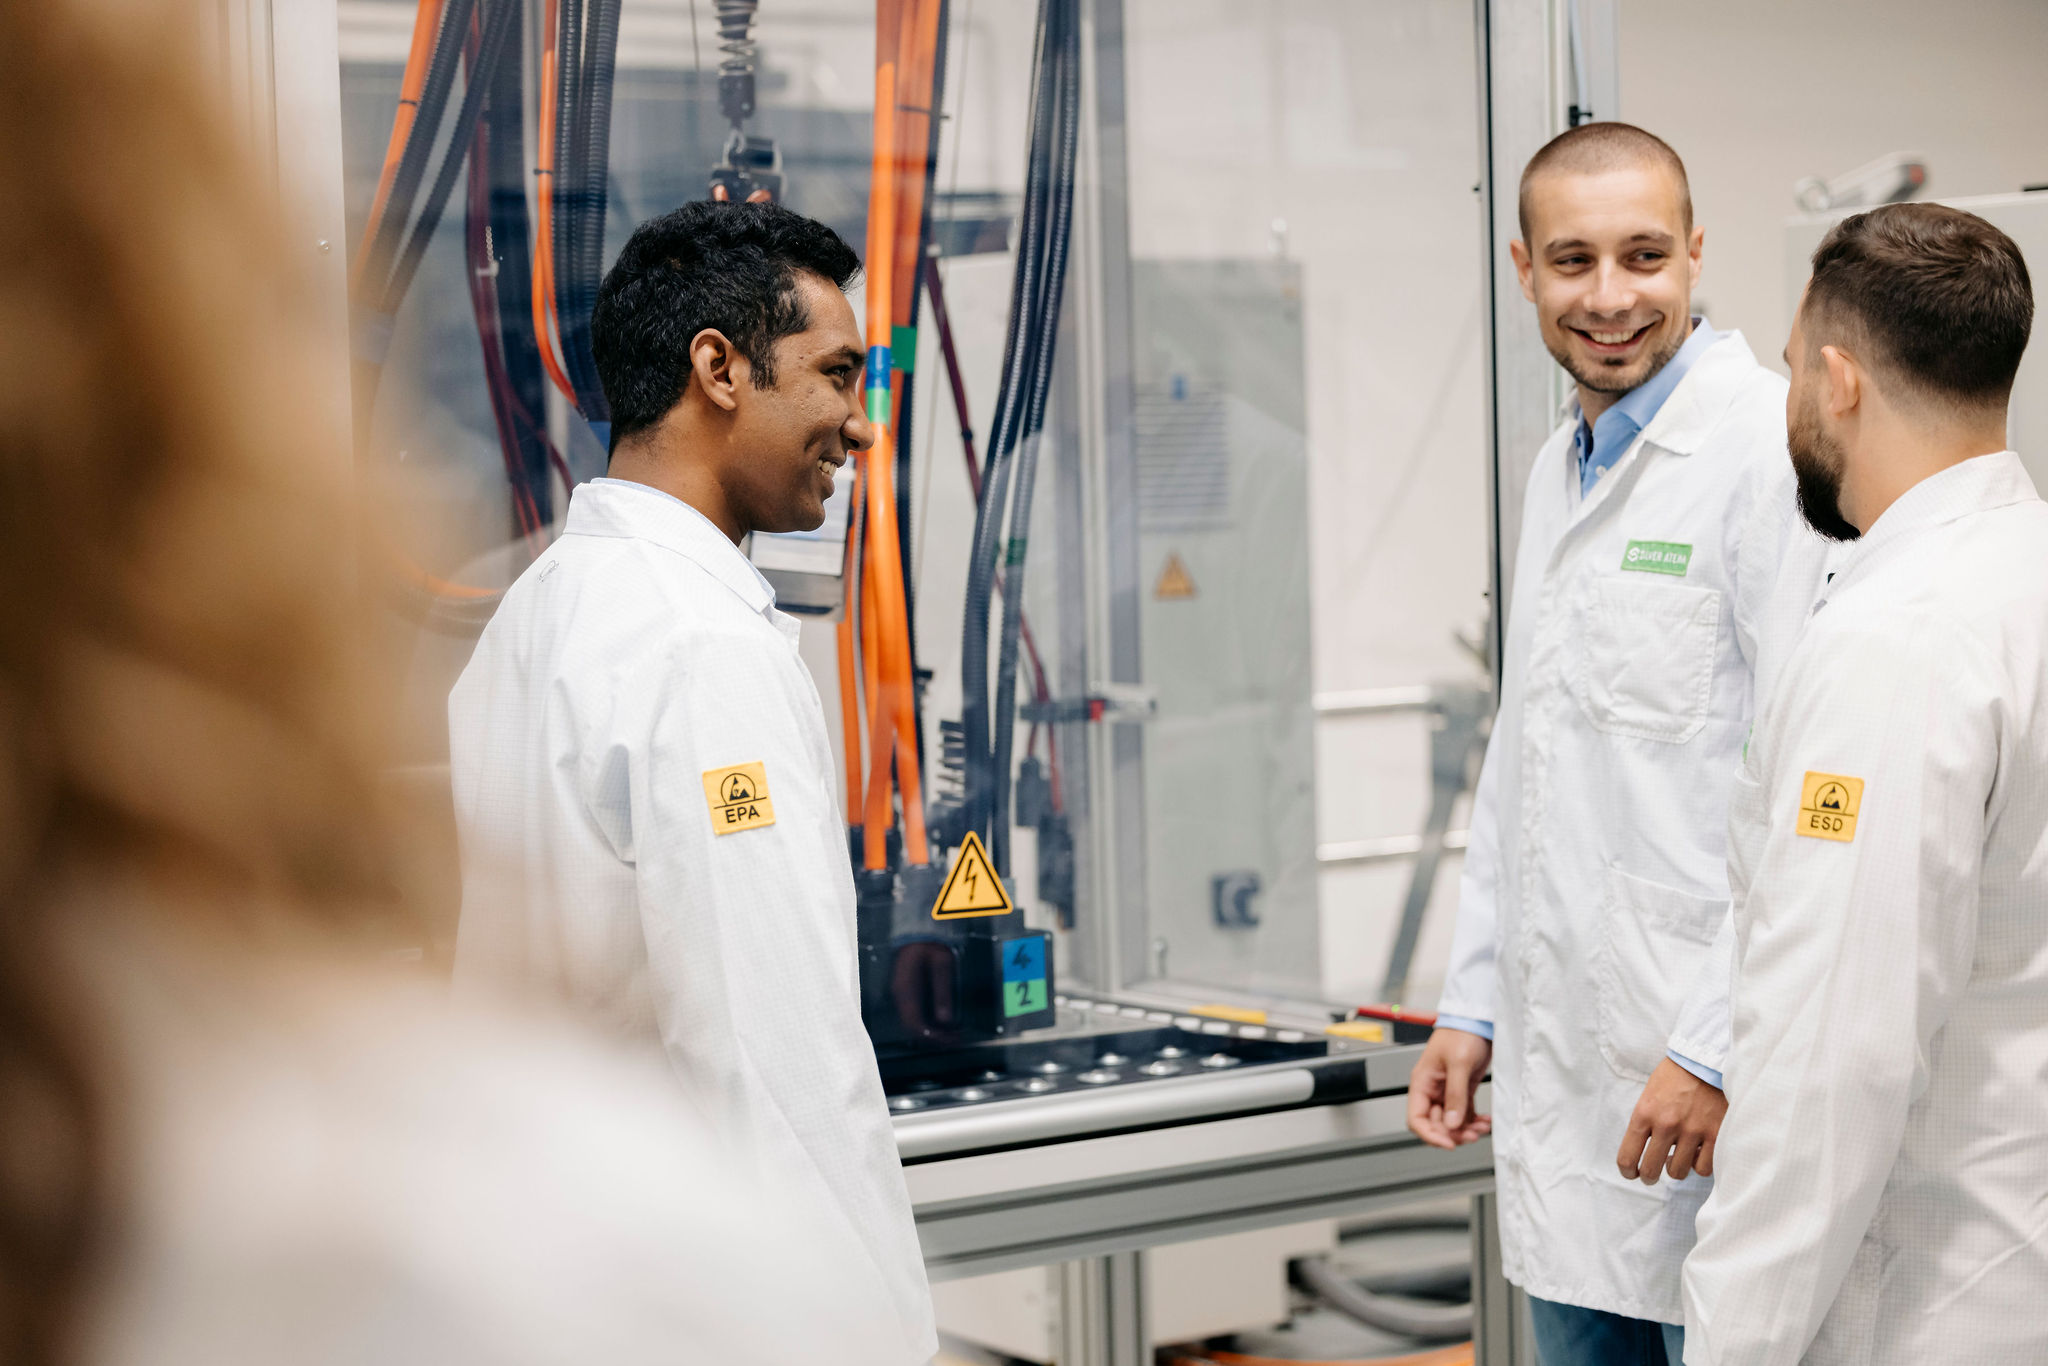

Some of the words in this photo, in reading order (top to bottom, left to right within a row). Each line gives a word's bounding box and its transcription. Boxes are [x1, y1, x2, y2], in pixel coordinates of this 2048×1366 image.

[725, 805, 760, 823] EPA
[1810, 814, 1843, 832] ESD
[1012, 944, 1032, 969] 4
[1016, 982, 1032, 1006] 2
